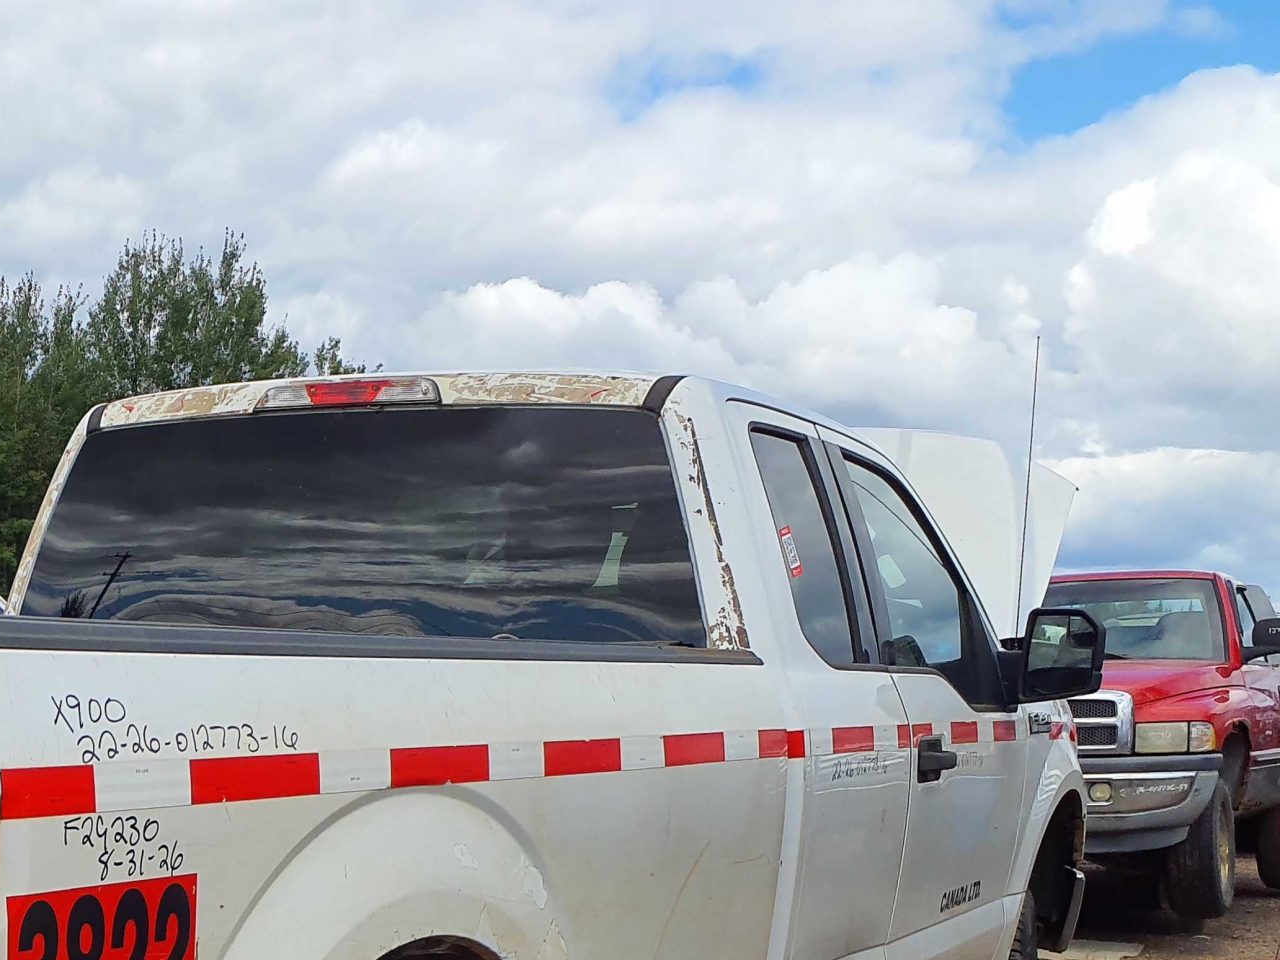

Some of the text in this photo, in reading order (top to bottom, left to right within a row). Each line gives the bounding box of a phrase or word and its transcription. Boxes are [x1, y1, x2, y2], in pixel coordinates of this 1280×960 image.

[51, 694, 126, 733] X900
[98, 840, 184, 881] 8-31-26
[940, 885, 968, 913] CANADA
